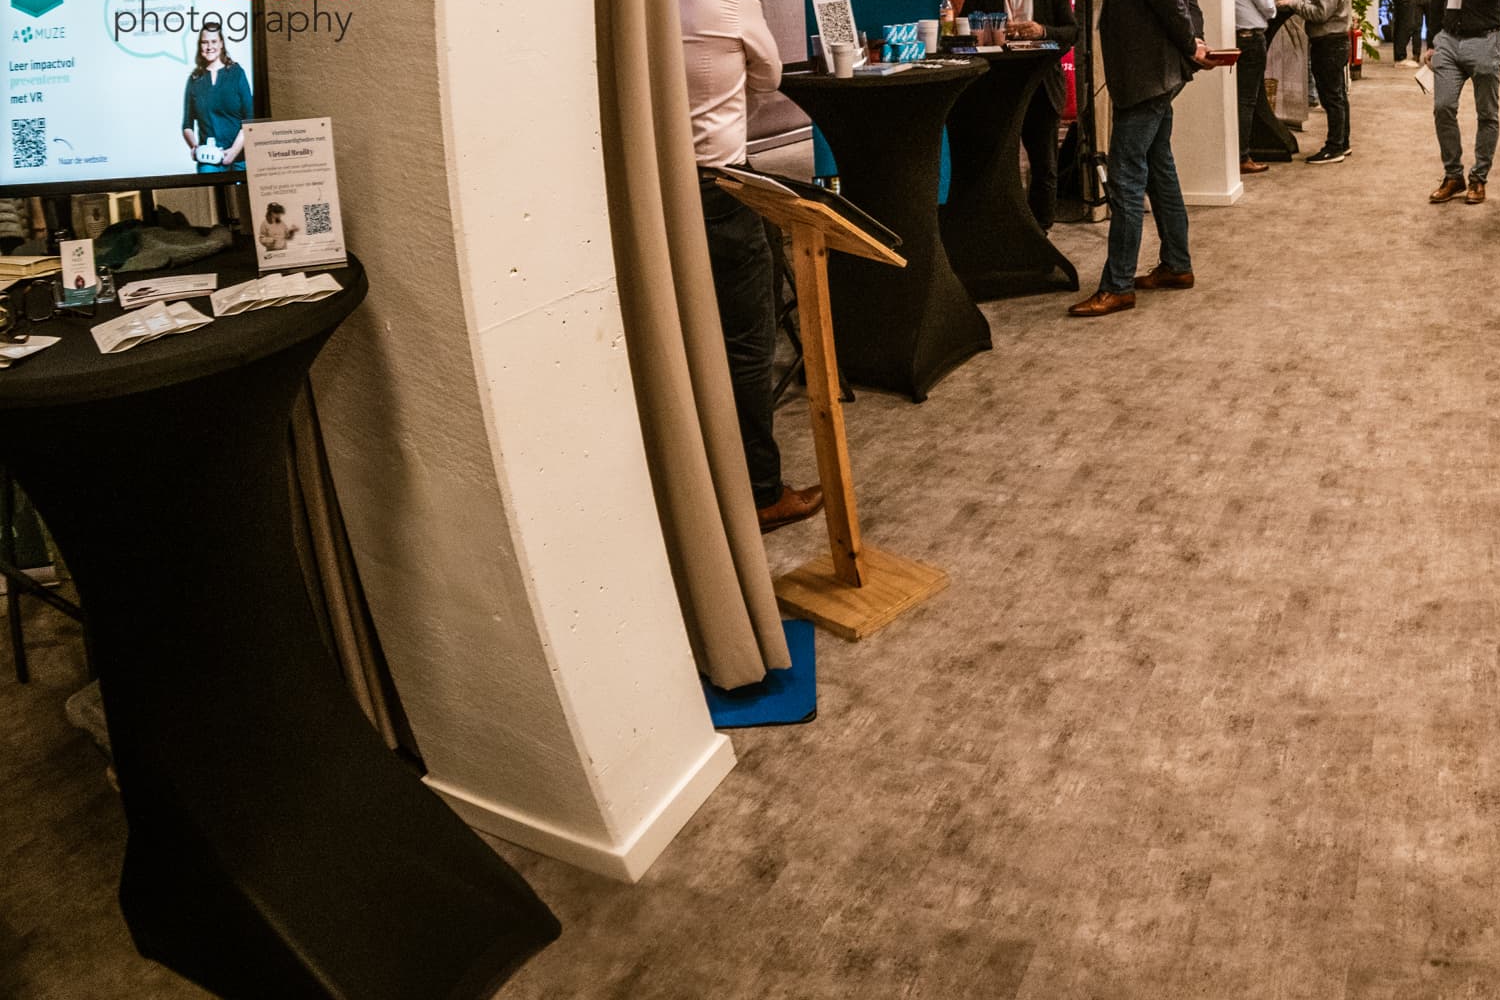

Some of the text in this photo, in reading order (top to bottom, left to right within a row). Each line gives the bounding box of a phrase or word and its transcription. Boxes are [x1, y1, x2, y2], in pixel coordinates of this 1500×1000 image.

[9, 56, 75, 72] Leer impactvol
[10, 91, 44, 105] met VR
